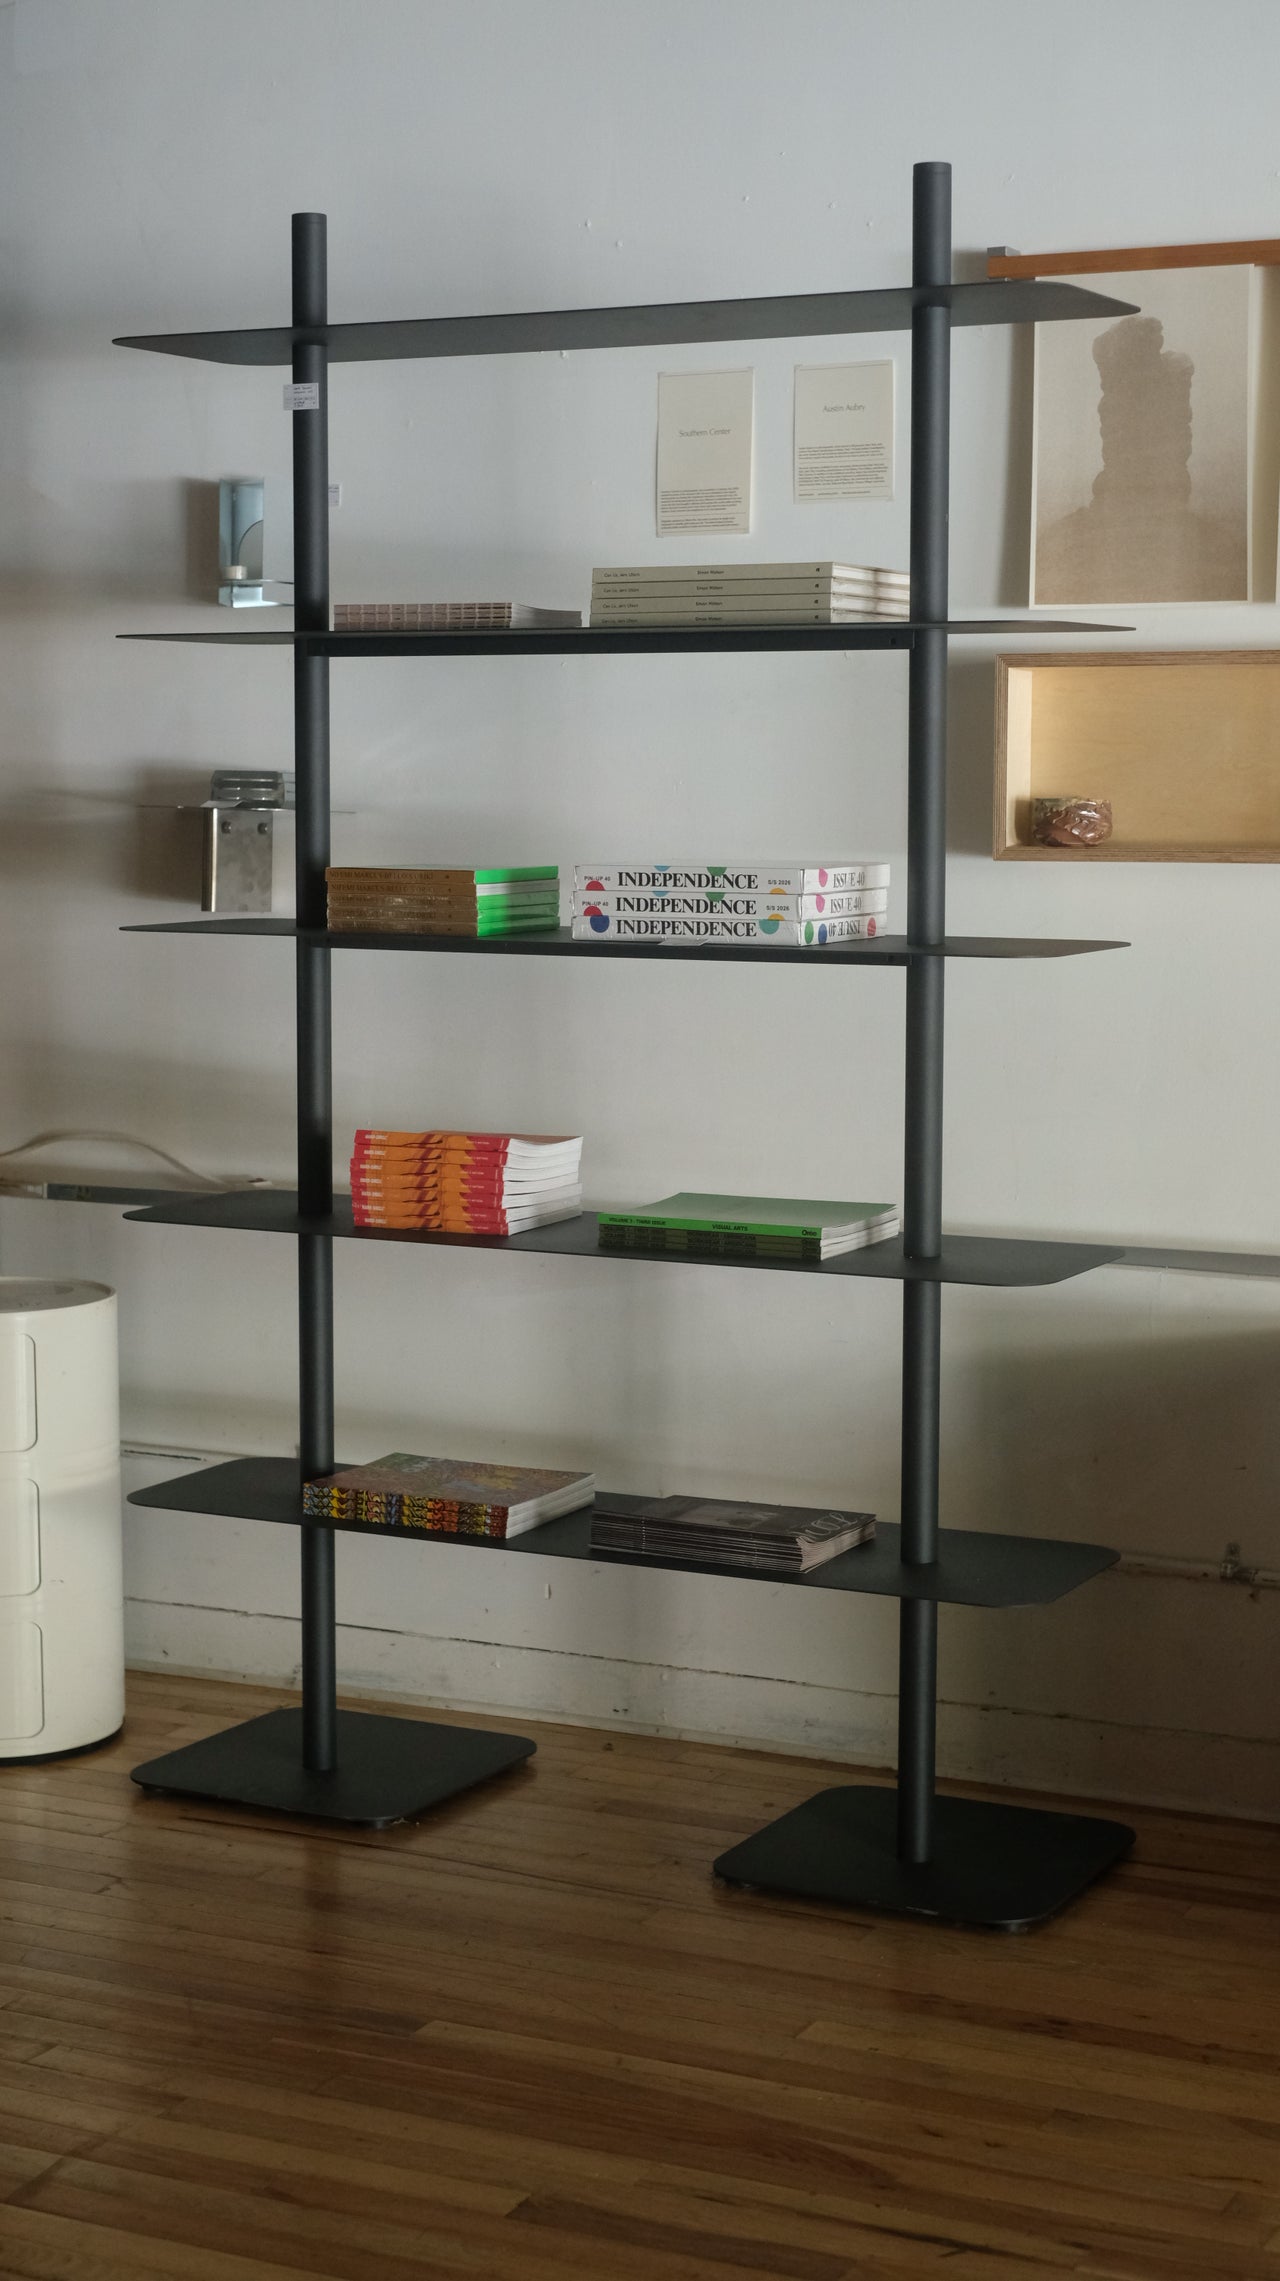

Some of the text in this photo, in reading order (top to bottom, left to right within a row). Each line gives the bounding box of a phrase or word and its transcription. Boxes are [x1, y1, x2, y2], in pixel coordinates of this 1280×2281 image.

[822, 404, 844, 412] Austin
[679, 428, 731, 437] Southern Center
[618, 872, 758, 889] INDEPENDENCE
[857, 872, 865, 886] 40
[616, 897, 757, 915] INDEPENDENCE
[854, 896, 862, 912] 40
[616, 920, 757, 937] INDEPENDENCE
[828, 920, 861, 937] ISSUE 40
